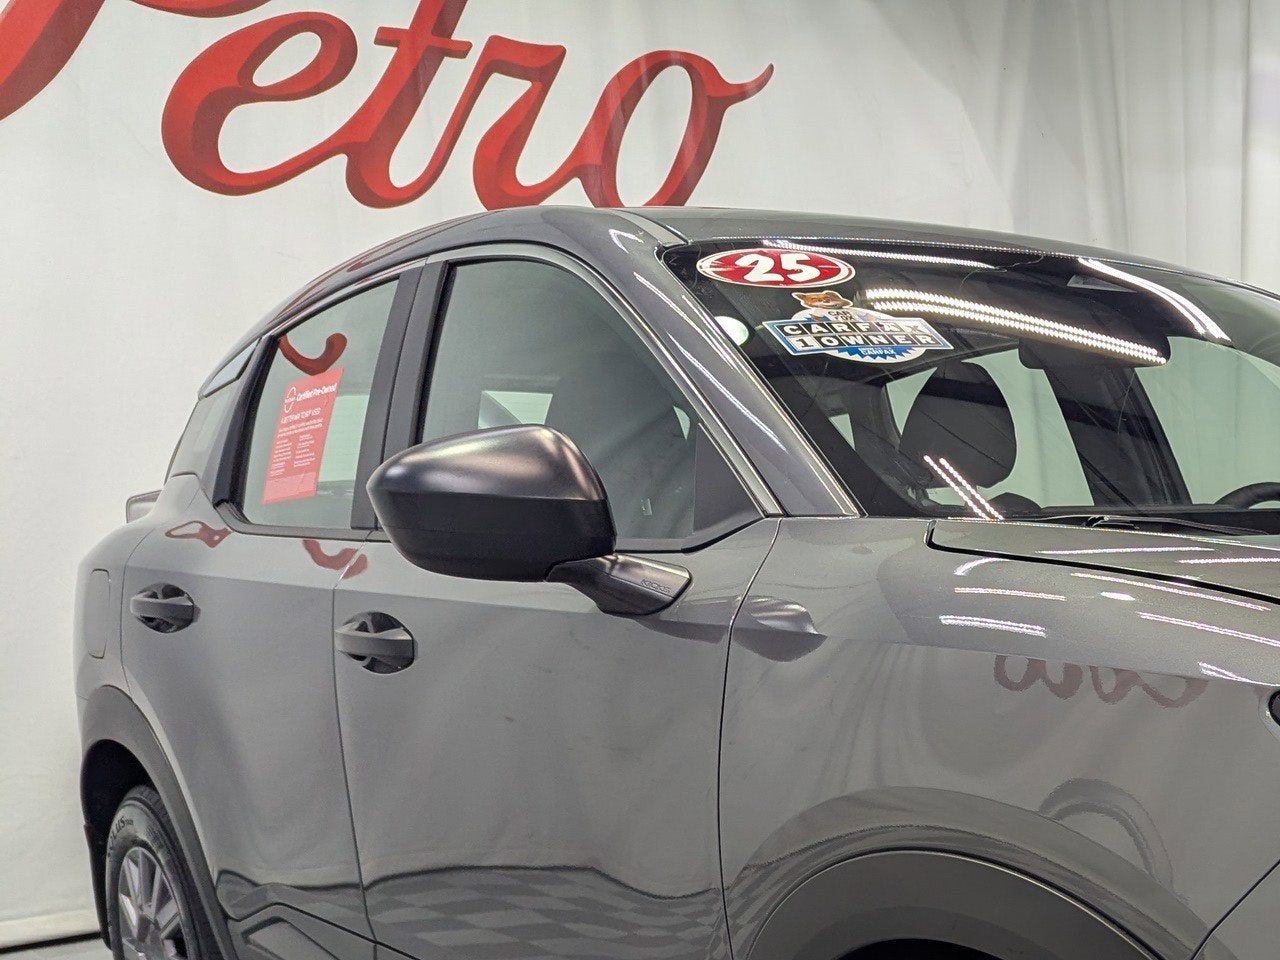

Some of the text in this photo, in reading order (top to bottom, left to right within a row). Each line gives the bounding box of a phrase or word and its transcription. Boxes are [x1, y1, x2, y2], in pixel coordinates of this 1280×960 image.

[0, 0, 775, 208] etro
[734, 252, 819, 282] 25
[782, 321, 927, 335] CARFAX
[794, 333, 938, 348] 1 OWNER
